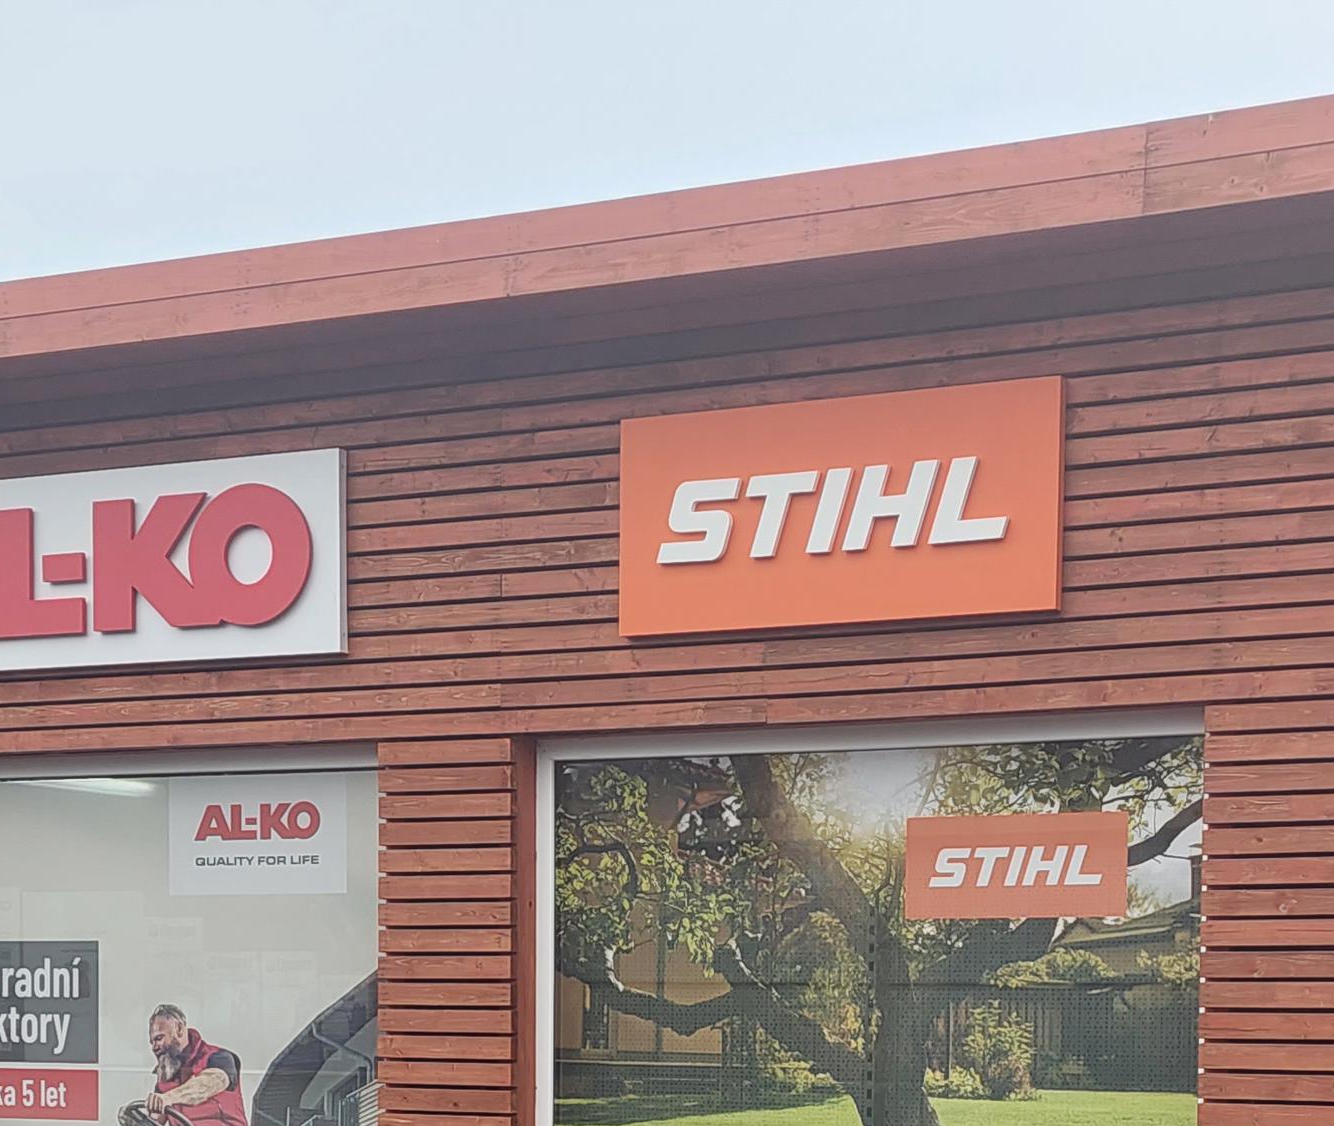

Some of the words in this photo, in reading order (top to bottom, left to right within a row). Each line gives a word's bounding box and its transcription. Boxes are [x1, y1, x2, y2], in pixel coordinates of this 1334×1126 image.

[656, 455, 1010, 566] STIHL
[194, 800, 321, 842] AL-KO
[195, 856, 255, 867] QUALITY
[257, 855, 287, 866] FOR
[289, 854, 320, 865] LIFE
[928, 844, 1103, 888] STIHL
[22, 1080, 36, 1108] 5
[39, 1080, 67, 1108] let
